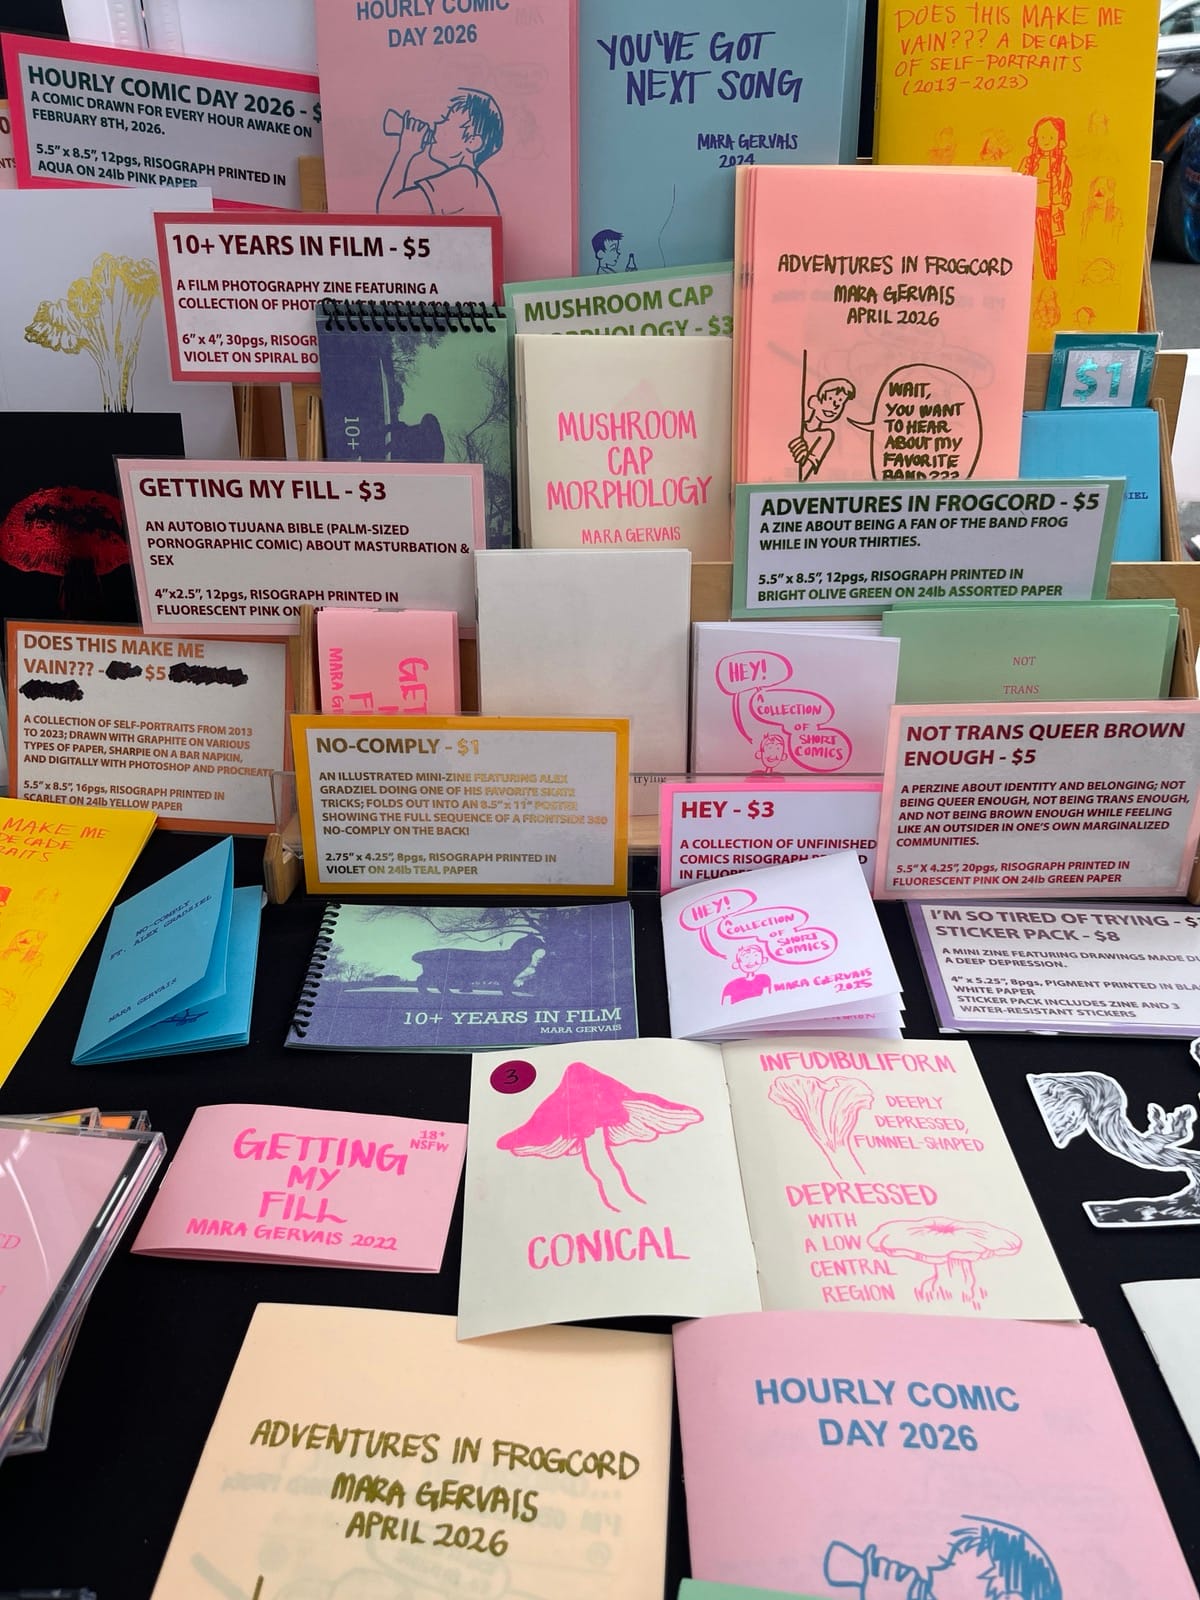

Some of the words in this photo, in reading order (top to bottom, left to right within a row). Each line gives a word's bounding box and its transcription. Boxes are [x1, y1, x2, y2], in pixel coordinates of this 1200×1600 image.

[357, 0, 436, 21] HOURLY
[442, 0, 510, 14] COMIC
[894, 5, 956, 33] DOES
[1022, 5, 1090, 29] MAKE
[1098, 7, 1126, 28] ME
[388, 26, 427, 47] DAY
[433, 23, 477, 45] 2026
[901, 29, 989, 56] VAIN???
[997, 33, 1009, 49] A
[1022, 32, 1098, 50] DECADE
[597, 30, 700, 71] YOU'VE
[710, 31, 777, 63] GOT
[895, 59, 923, 78] OF
[930, 54, 1083, 73] SELF-PORTRAITS
[27, 65, 115, 93] HOURLY
[120, 77, 191, 103] COMIC
[196, 86, 238, 109] DAY
[244, 94, 295, 117] 2026
[627, 69, 712, 106] NEXT
[717, 68, 804, 103] SONG
[32, 108, 97, 126] FEBRUARY
[100, 116, 128, 131] 8TH,
[131, 120, 165, 135] 2026.
[697, 133, 734, 151] MARA
[738, 133, 798, 150] GERVAIS
[172, 234, 214, 254] 10+
[218, 234, 294, 255] YEARS
[299, 235, 323, 256] IN
[329, 236, 383, 257] FILM
[403, 236, 430, 260] $5
[778, 253, 894, 276] ADVENTURES
[901, 256, 919, 274] IN
[925, 256, 1013, 277] FROGCORD
[177, 279, 185, 290] A
[188, 279, 219, 291] FILM
[221, 280, 320, 292] PHOTOGRAPHY
[323, 281, 352, 293] ZINE
[355, 282, 426, 294] FEATURING
[429, 283, 438, 294] A
[834, 284, 878, 304] MARA
[883, 284, 956, 306] GERVAIS
[524, 290, 663, 323] MUSHROOM
[669, 284, 714, 305] CAP
[847, 307, 893, 325] APRIL
[897, 310, 940, 327] 2026
[1073, 356, 1125, 404] $1
[557, 409, 698, 443] MUSHROOM
[607, 446, 654, 477] CAP
[139, 477, 243, 498] GETTING
[249, 479, 285, 498] MY
[291, 480, 339, 499] FILL
[358, 479, 386, 502] $3
[546, 475, 713, 511] MORPHOLOGY
[760, 495, 902, 516] ADVENTURES
[908, 495, 930, 512] IN
[935, 493, 1055, 511] FROGCORD
[1072, 491, 1099, 512] $5
[145, 520, 164, 531] AN
[167, 521, 226, 532] AUTOBIO
[228, 521, 284, 533] TIJUANA
[287, 522, 324, 533] BIBLE
[326, 523, 409, 535] (PALM-SIZED
[582, 528, 622, 545] MARA
[625, 526, 681, 543] GERVAIS
[759, 538, 801, 550] WHILE
[804, 537, 817, 549] IN
[820, 536, 856, 548] YOUR
[859, 535, 920, 547] THIRTIES.
[150, 554, 175, 567] SEX
[24, 633, 73, 651] DOES
[75, 636, 117, 653] THIS
[121, 639, 173, 656] MAKE
[177, 642, 204, 658] ME
[24, 658, 95, 677] VAIN???
[145, 663, 167, 682] $5
[729, 659, 768, 683] HEY!
[23, 714, 31, 723] A
[33, 714, 96, 727] COLLECTION
[97, 718, 111, 727] OF
[113, 719, 195, 733] SELF-PORTRAITS
[197, 724, 226, 735] FROM
[228, 726, 252, 736] 2013
[907, 725, 951, 741] NOT
[954, 724, 1024, 740] TRANS
[1029, 723, 1099, 741] QUEER
[1103, 722, 1185, 738] BROWN
[316, 736, 441, 756] NO-COMPLY
[457, 738, 480, 757] $1
[904, 749, 994, 766] ENOUGH
[1011, 748, 1036, 765] $5
[681, 801, 728, 819] HEY
[747, 800, 775, 820] $3
[323, 825, 391, 835] NO-COMPLY
[393, 825, 410, 835] ON
[412, 826, 434, 835] THE
[436, 826, 469, 835] BACK!
[680, 839, 689, 849] A
[692, 838, 772, 849] COLLECTION
[776, 838, 793, 848] OF
[797, 839, 877, 849] UNFINISHED
[896, 837, 980, 848] COMMUNITIES.
[930, 909, 961, 920] I'M
[965, 910, 993, 921] SO
[995, 911, 1056, 923] TIRED
[1060, 913, 1088, 924] OF
[1090, 913, 1169, 926] TRYING
[935, 925, 1020, 939] STICKER
[1023, 928, 1079, 940] PACK
[1093, 930, 1120, 942] $8
[403, 1012, 443, 1024] 10+
[451, 1010, 527, 1024] YEARS
[534, 1010, 560, 1023] IN
[565, 1007, 621, 1022] FILM
[575, 1024, 621, 1032] GERVAIS
[759, 1051, 957, 1074] INFUDIBULIFORM
[503, 1069, 519, 1085] 3
[885, 1095, 944, 1110] DEEPLY
[875, 1115, 970, 1135] DEPRESSED,
[233, 1128, 408, 1176] GETTING
[409, 1138, 449, 1153] NSFW
[853, 1134, 985, 1152] FUNNEL-SHAPED
[287, 1165, 341, 1192] MY
[785, 1182, 939, 1208] DEPRESSED
[258, 1190, 348, 1224] FILL
[808, 1212, 858, 1229] WITH
[186, 1218, 247, 1237] MARA
[254, 1224, 343, 1246] GERVAIS
[351, 1234, 399, 1251] 2022
[804, 1237, 818, 1254] A
[823, 1234, 862, 1252] LOW
[528, 1226, 691, 1271] CONICAL
[810, 1259, 899, 1279] CENTRAL
[822, 1284, 896, 1304] REGION
[755, 1377, 897, 1406] HOURLY
[907, 1381, 1021, 1413] COMIC
[818, 1417, 889, 1448] DAY
[899, 1421, 979, 1453] 2026
[250, 1418, 441, 1465] ADVENTURES
[452, 1436, 482, 1465] IN
[492, 1439, 640, 1481] FROGCORD
[330, 1472, 407, 1509] MARA
[416, 1478, 540, 1524] GERVAIS
[345, 1511, 425, 1545] APRIL
[432, 1523, 510, 1557] 2026
